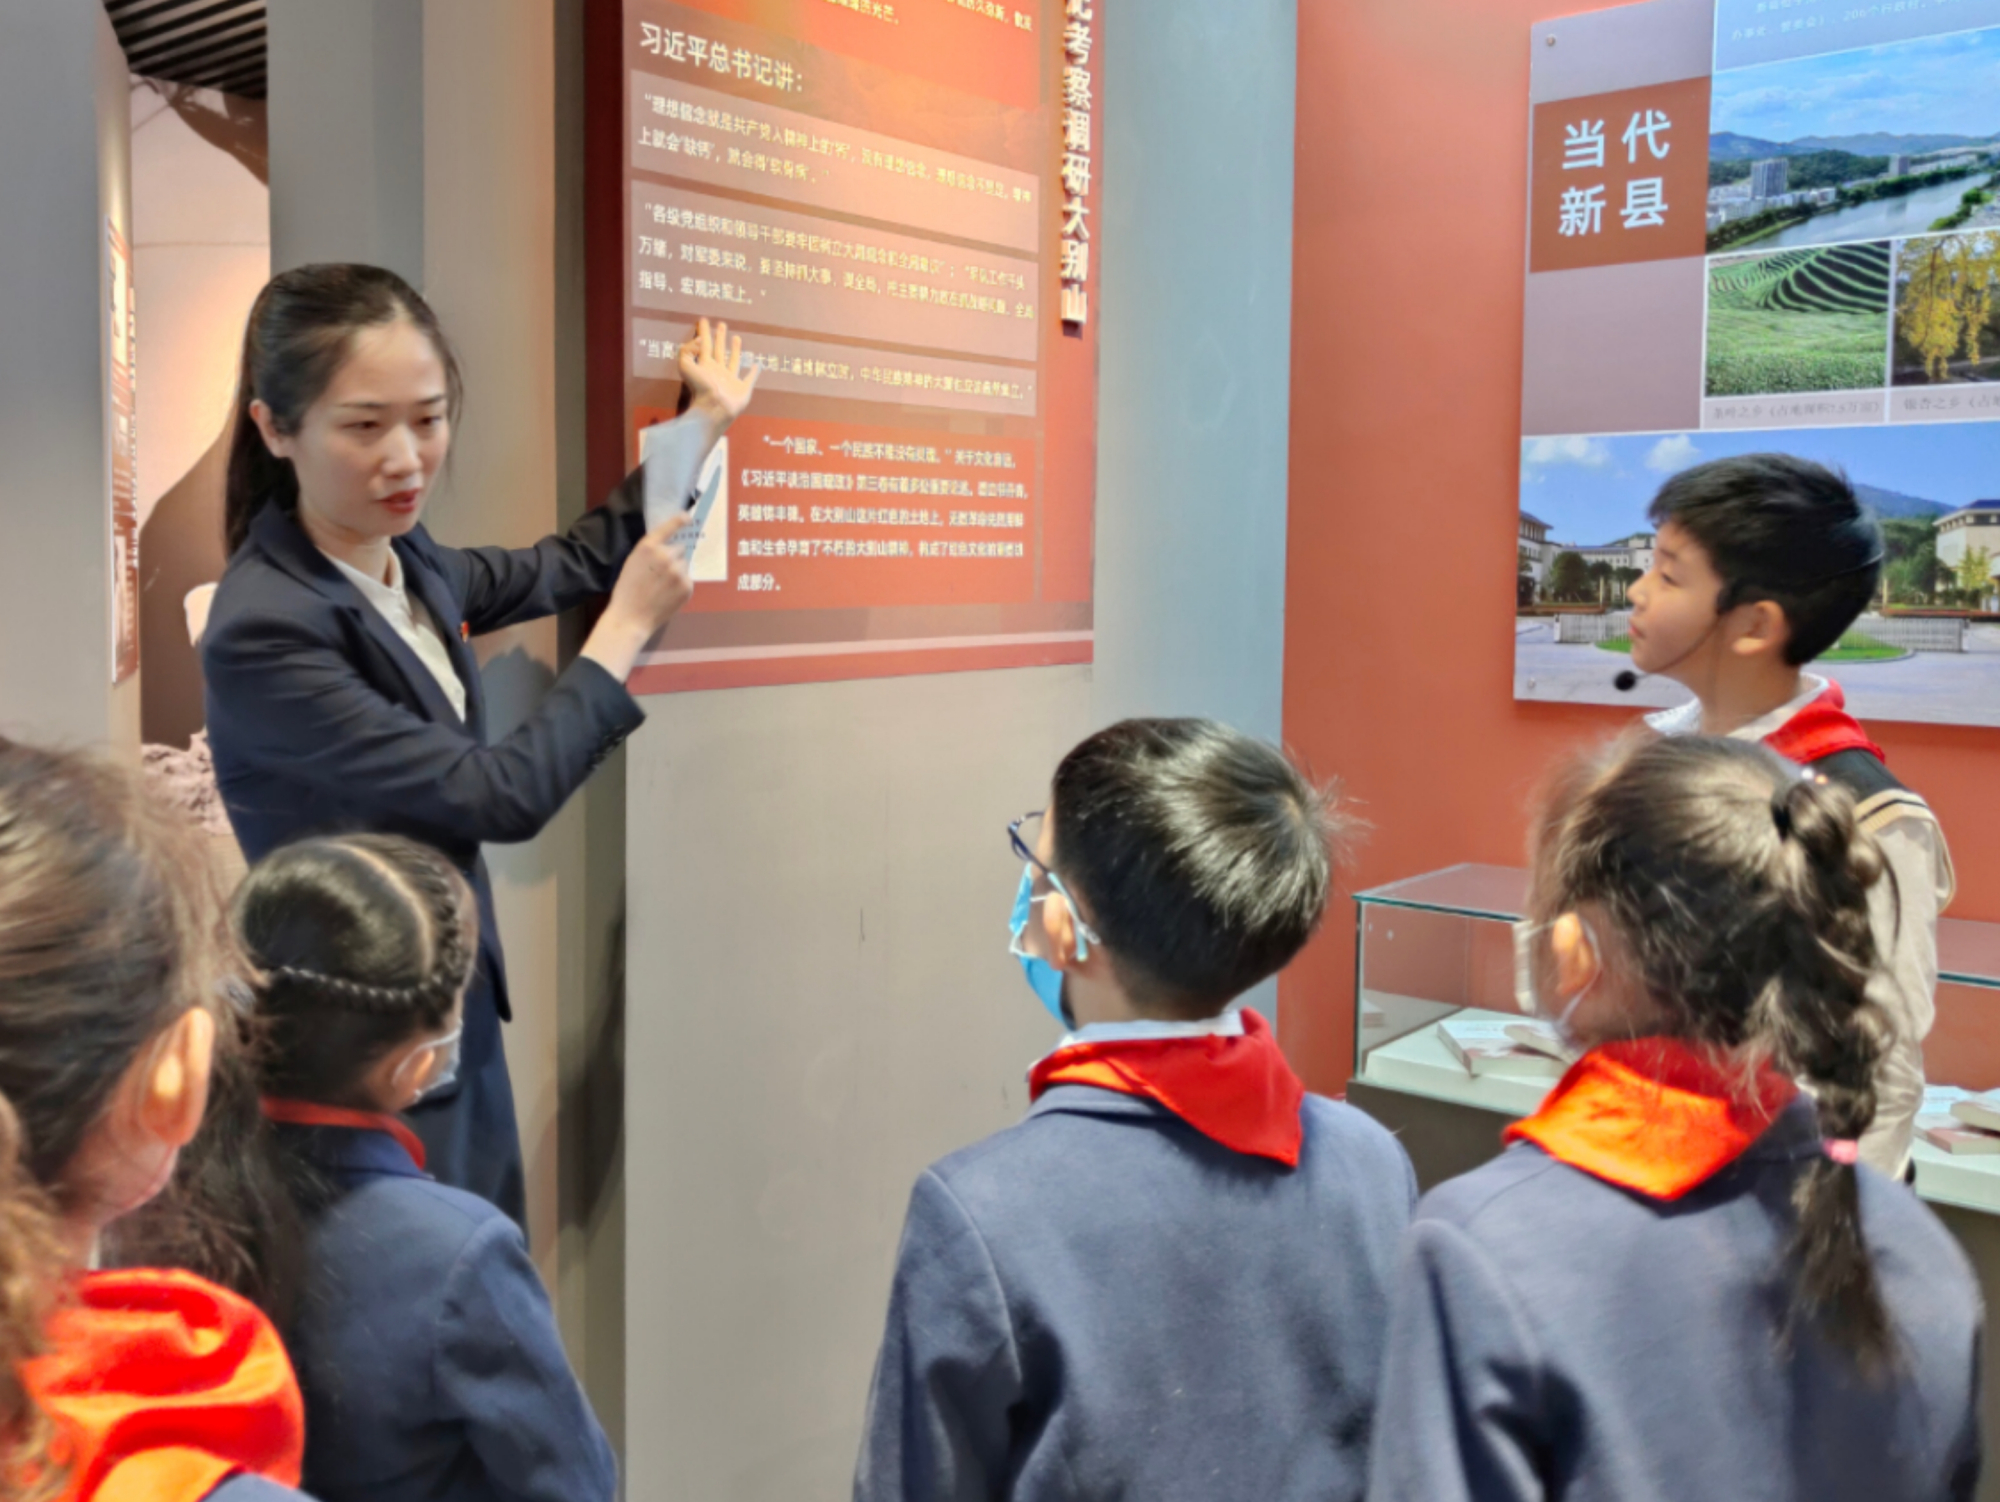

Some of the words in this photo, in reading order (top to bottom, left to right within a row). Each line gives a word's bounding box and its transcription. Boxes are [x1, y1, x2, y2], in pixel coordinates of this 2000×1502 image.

[640, 21, 803, 92] 习近平总书记讲：
[1562, 109, 1671, 170] 当代
[1558, 177, 1669, 236] 新县
[737, 573, 781, 591] 成部分。
